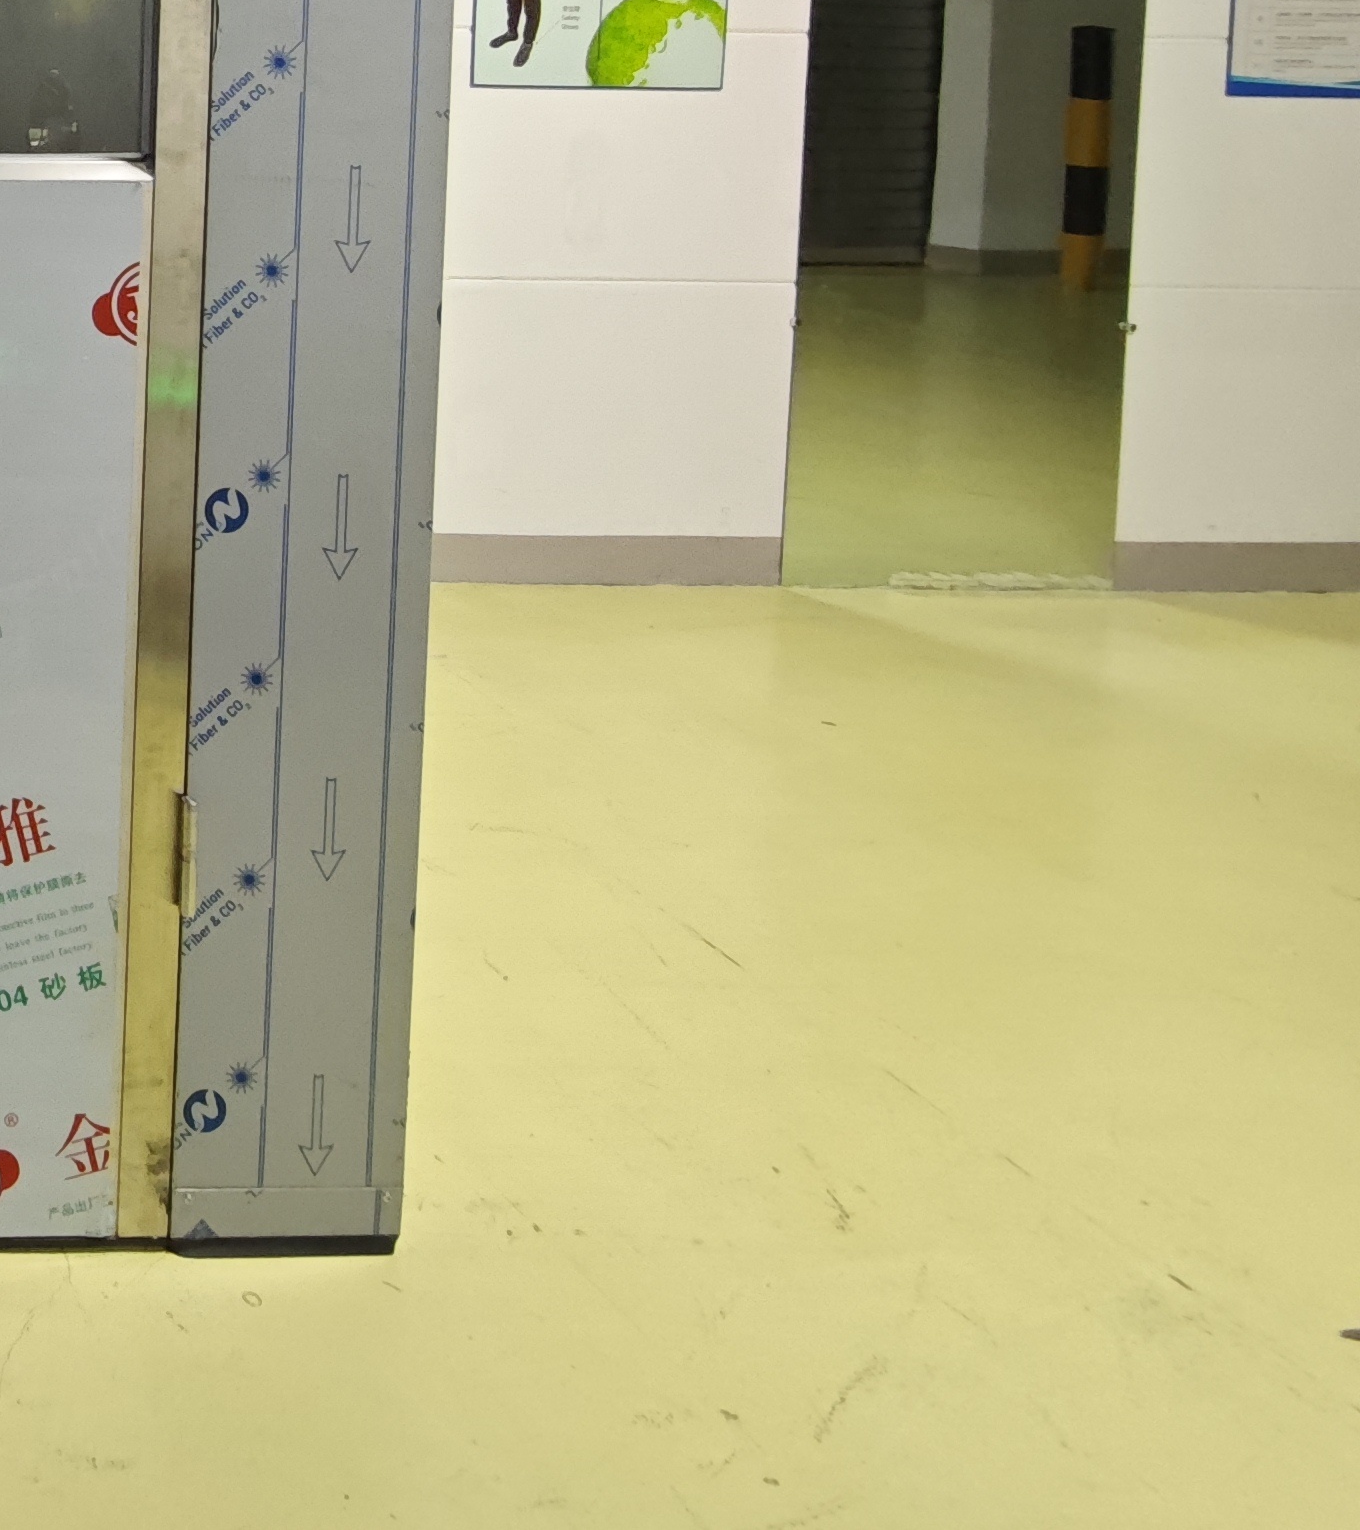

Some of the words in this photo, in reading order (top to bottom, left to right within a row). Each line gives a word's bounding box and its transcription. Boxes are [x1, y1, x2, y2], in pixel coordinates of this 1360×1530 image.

[209, 108, 241, 137] Fiber
[201, 315, 234, 344] Fiber
[186, 723, 219, 752] Fiber
[180, 924, 212, 952] Fiber
[55, 1113, 111, 1180] 金
